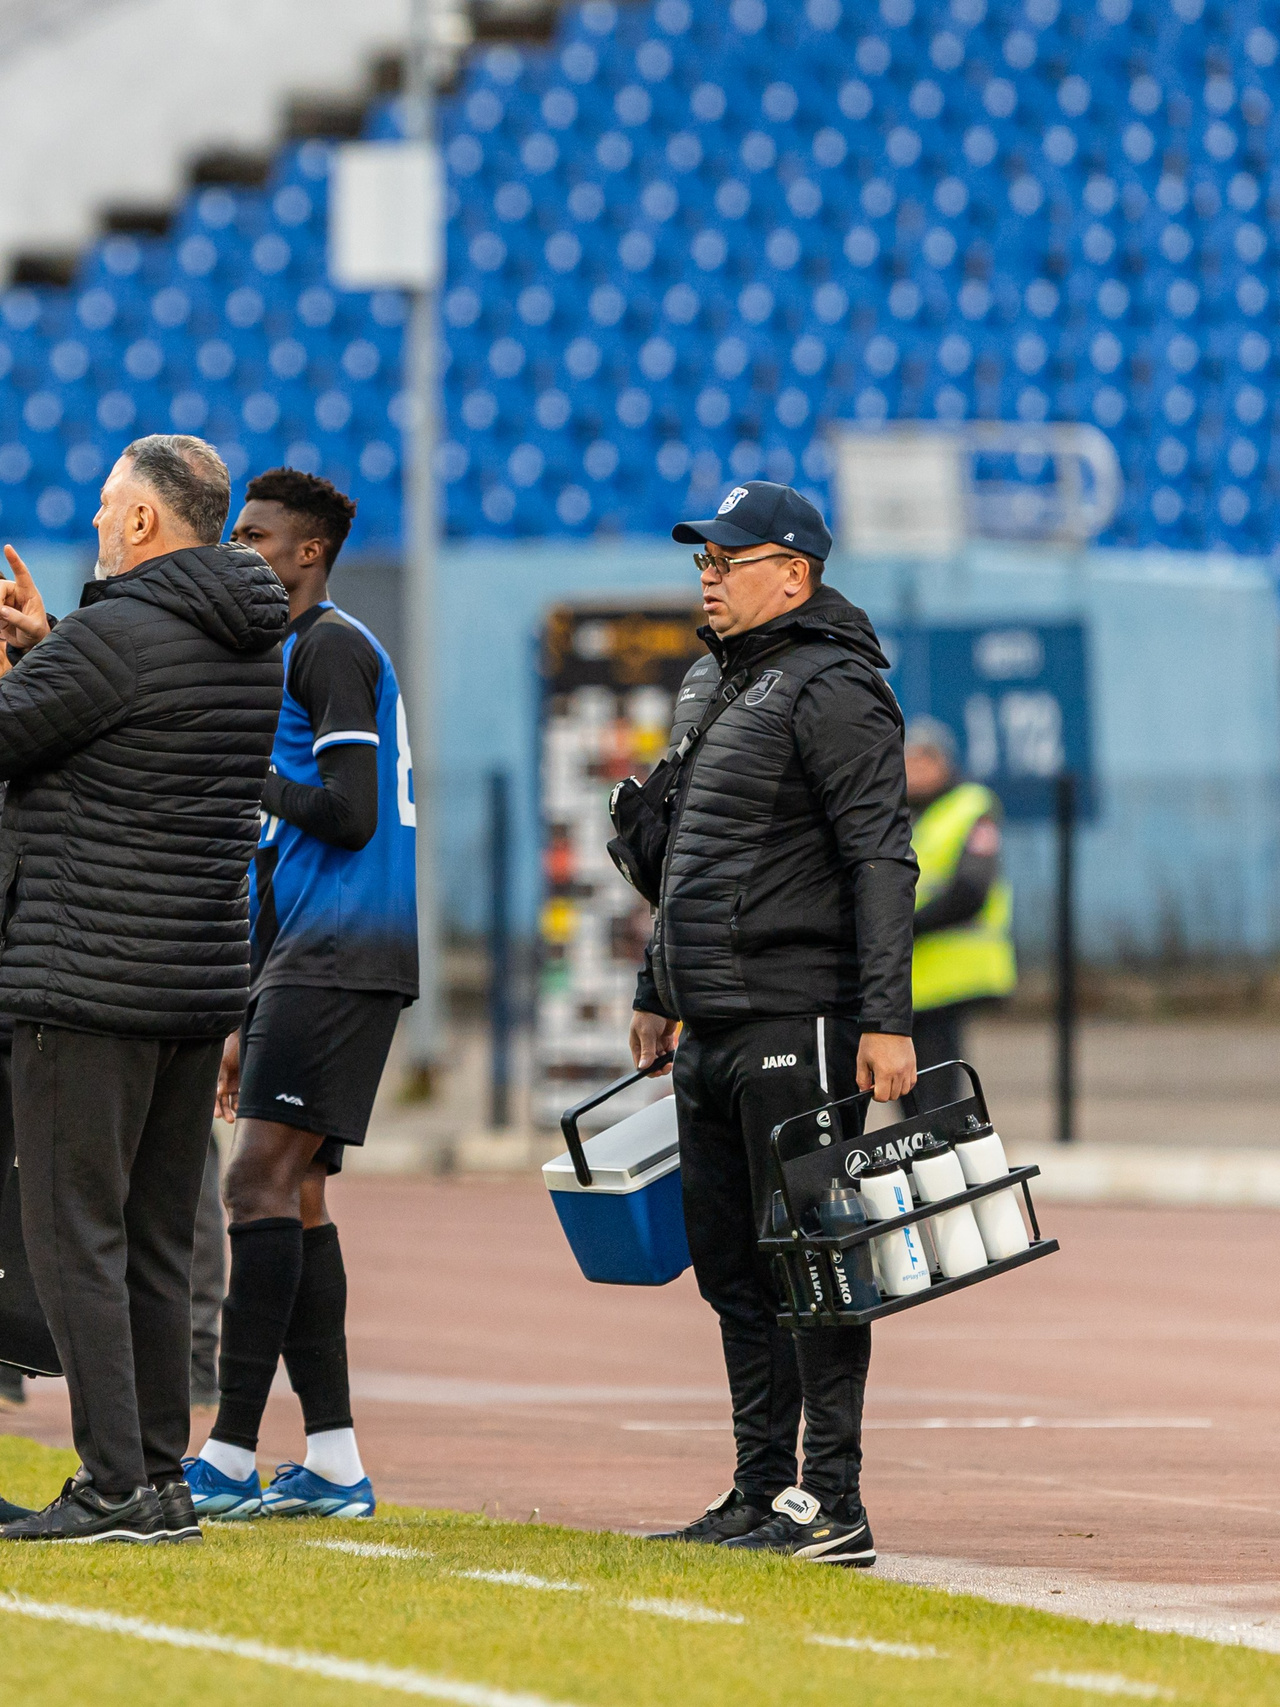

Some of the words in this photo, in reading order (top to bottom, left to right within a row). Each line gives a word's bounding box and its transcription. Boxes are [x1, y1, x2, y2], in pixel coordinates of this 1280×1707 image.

[762, 1053, 797, 1069] JAKO
[835, 1266, 852, 1305] JAKO
[783, 1498, 805, 1514] PUMA
